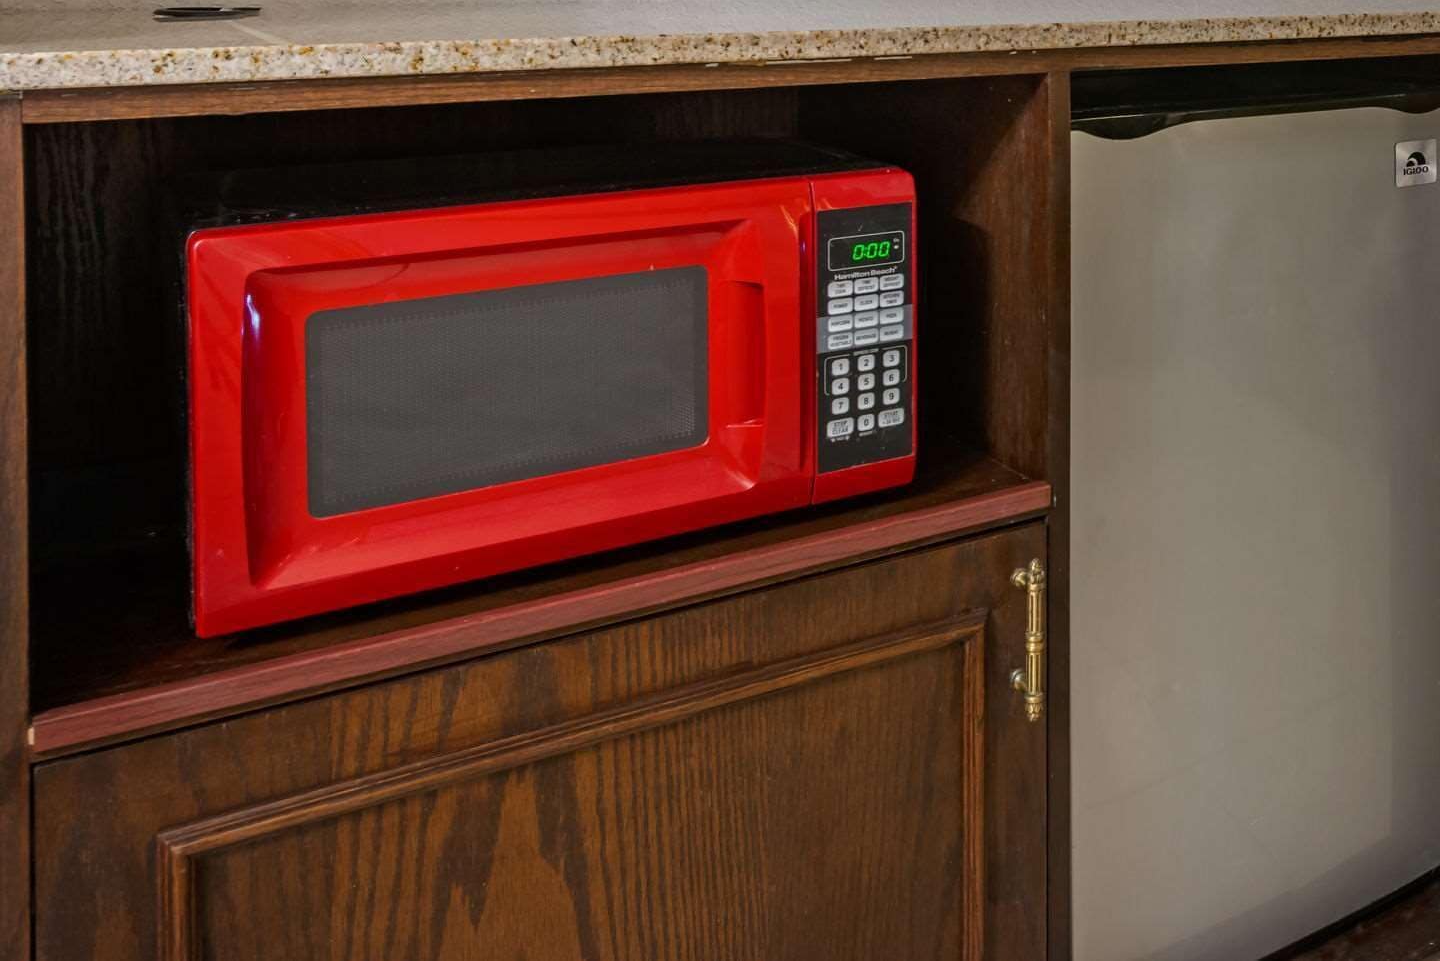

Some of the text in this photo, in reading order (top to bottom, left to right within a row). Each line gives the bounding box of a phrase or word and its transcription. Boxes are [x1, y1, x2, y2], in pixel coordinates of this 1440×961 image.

[852, 241, 891, 260] 0:00
[834, 271, 870, 280] Hamilton
[888, 354, 895, 362] 3
[863, 359, 869, 367] 2
[863, 377, 869, 386] 5
[888, 374, 894, 382] 6
[888, 392, 894, 401] 9
[838, 401, 844, 409] 7
[863, 397, 869, 405] 8
[863, 418, 869, 426] 0
